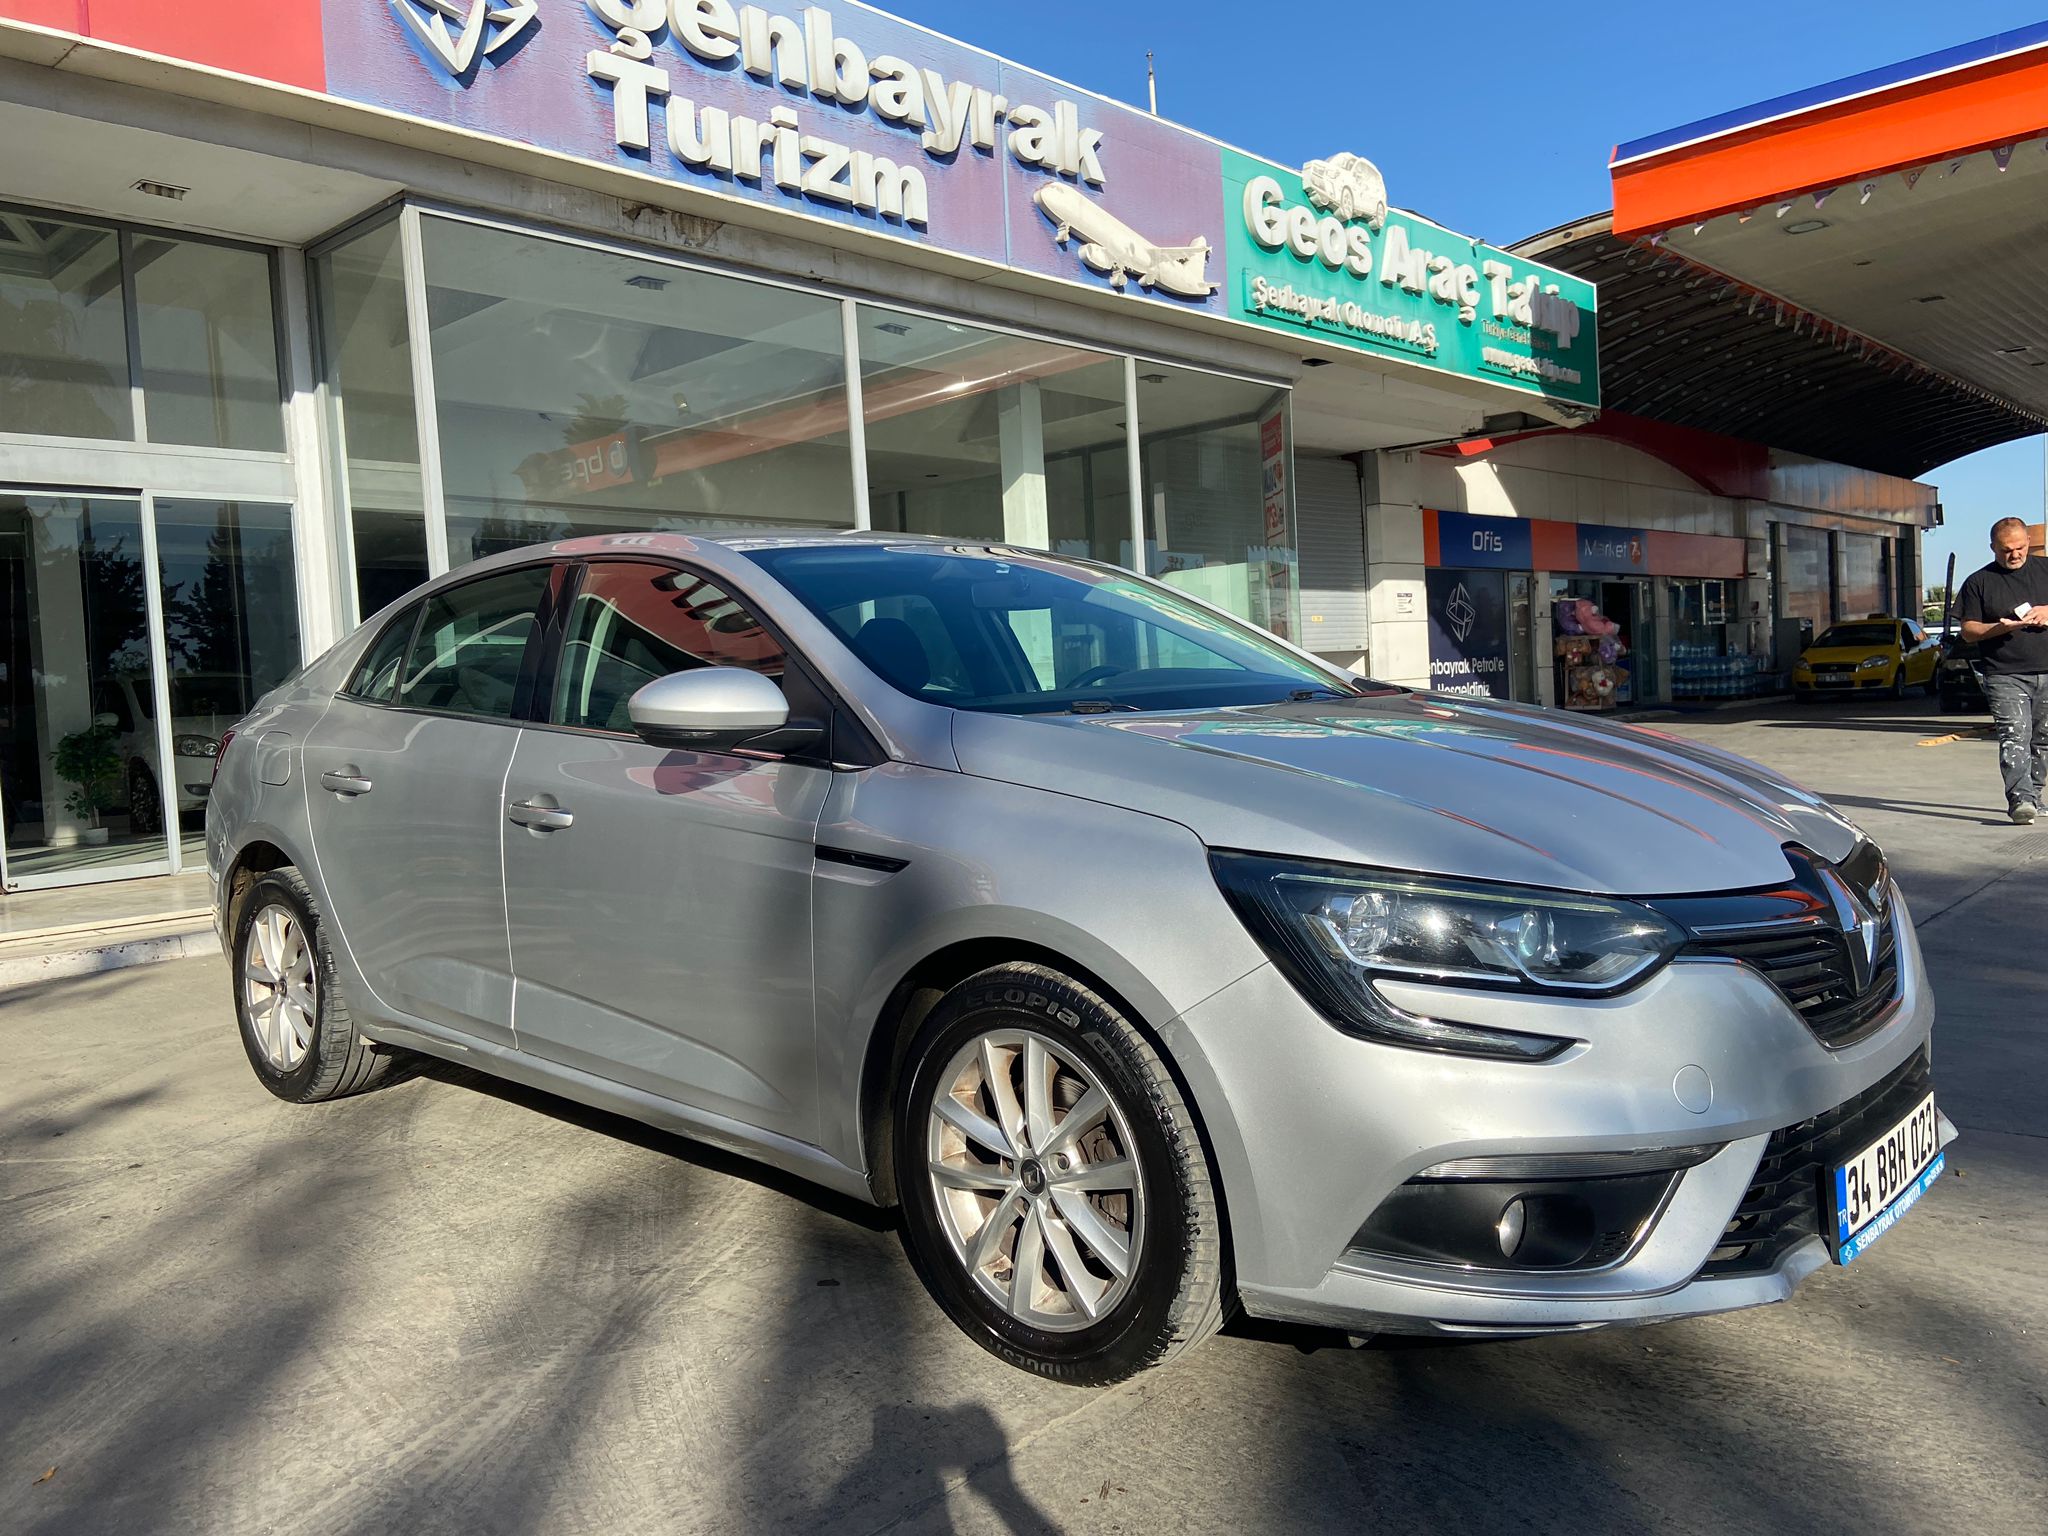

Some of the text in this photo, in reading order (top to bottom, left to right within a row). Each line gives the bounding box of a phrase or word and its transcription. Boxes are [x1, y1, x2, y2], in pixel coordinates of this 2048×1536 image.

[586, 49, 928, 224] Turizm
[1243, 175, 1373, 274] Geos
[1379, 225, 1481, 322] Araç
[1471, 531, 1503, 552] Ofis
[1584, 538, 1628, 559] Market
[1848, 1157, 1871, 1226] 34
[1876, 1126, 1908, 1203] BBH
[1911, 1101, 1934, 1171] 023
[1838, 1208, 1848, 1228] TR
